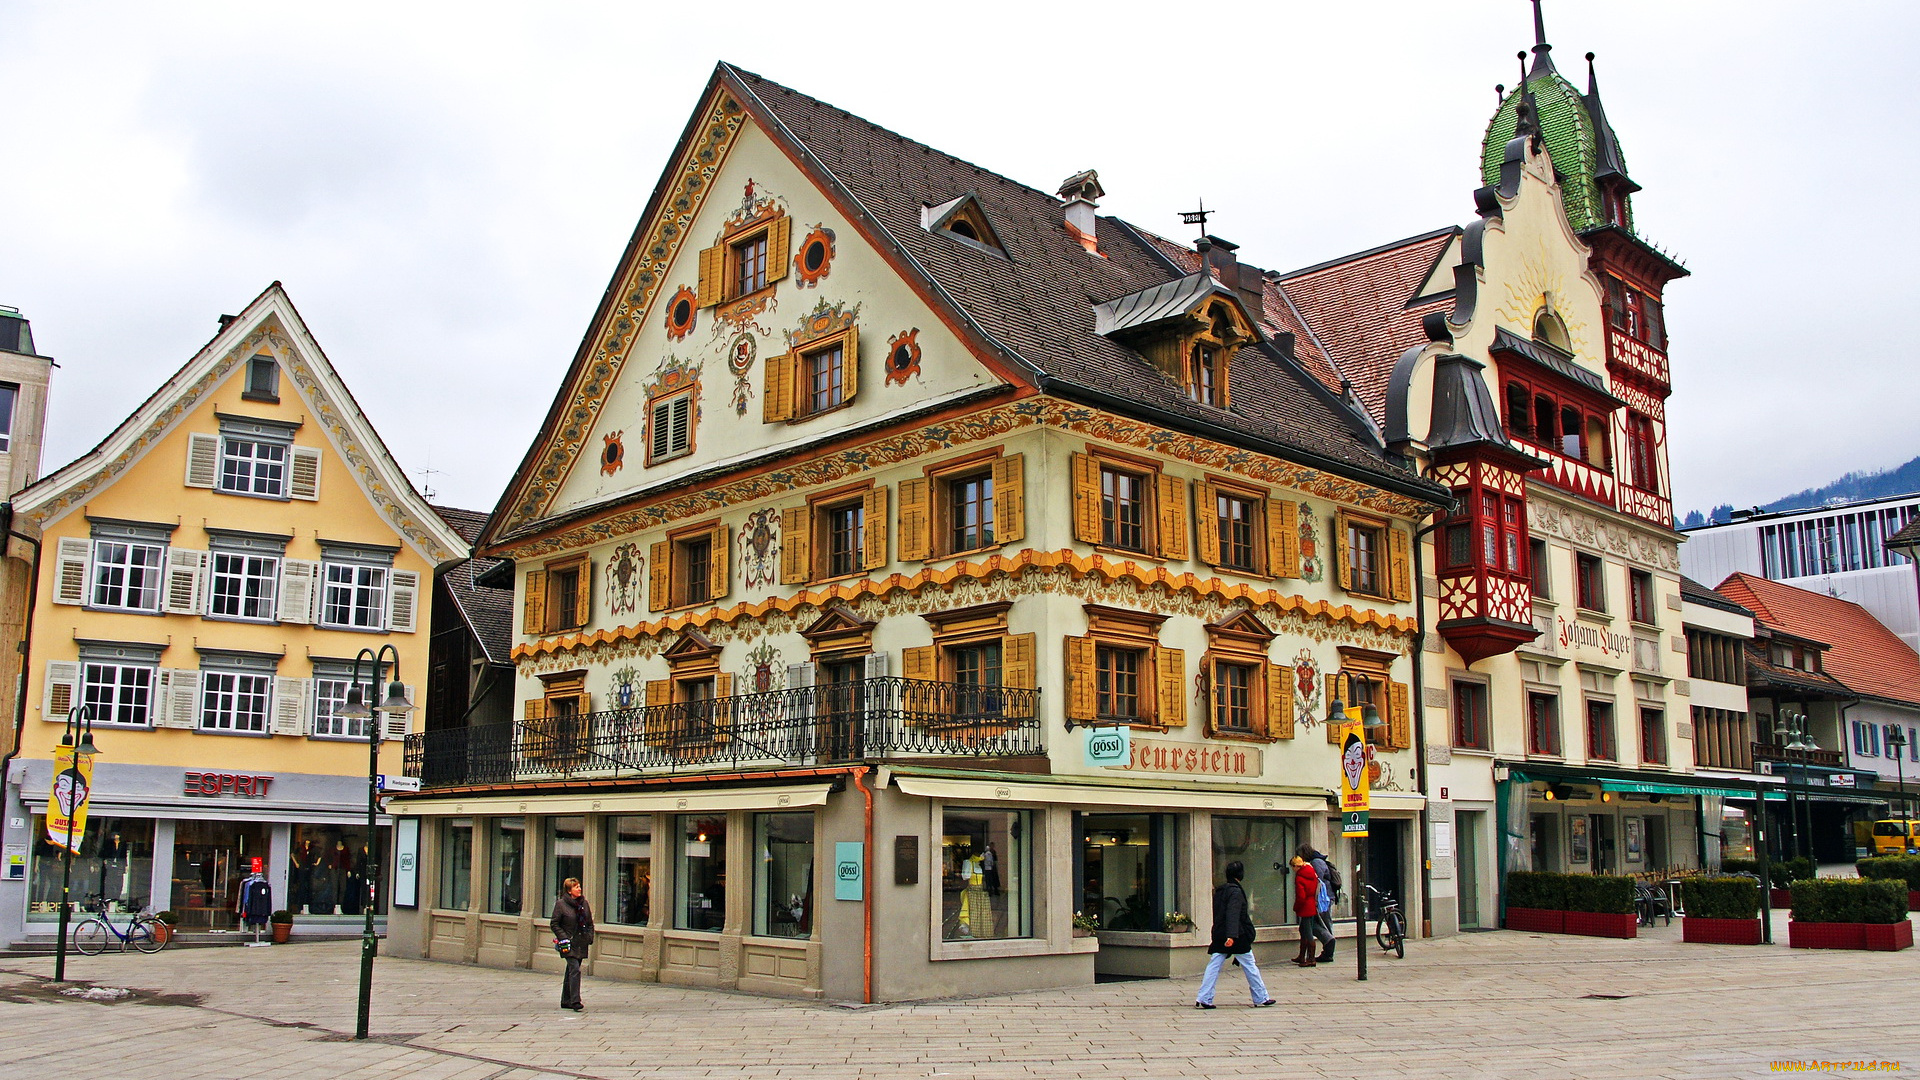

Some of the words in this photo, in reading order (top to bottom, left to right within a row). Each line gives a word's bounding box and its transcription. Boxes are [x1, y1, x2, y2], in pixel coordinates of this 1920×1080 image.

[1558, 615, 1599, 649] Johann
[1600, 625, 1630, 659] Luger
[1093, 739, 1119, 756] gössl
[184, 772, 275, 797] ESPRIT
[1442, 788, 1447, 796] 9
[840, 864, 857, 878] gössl
